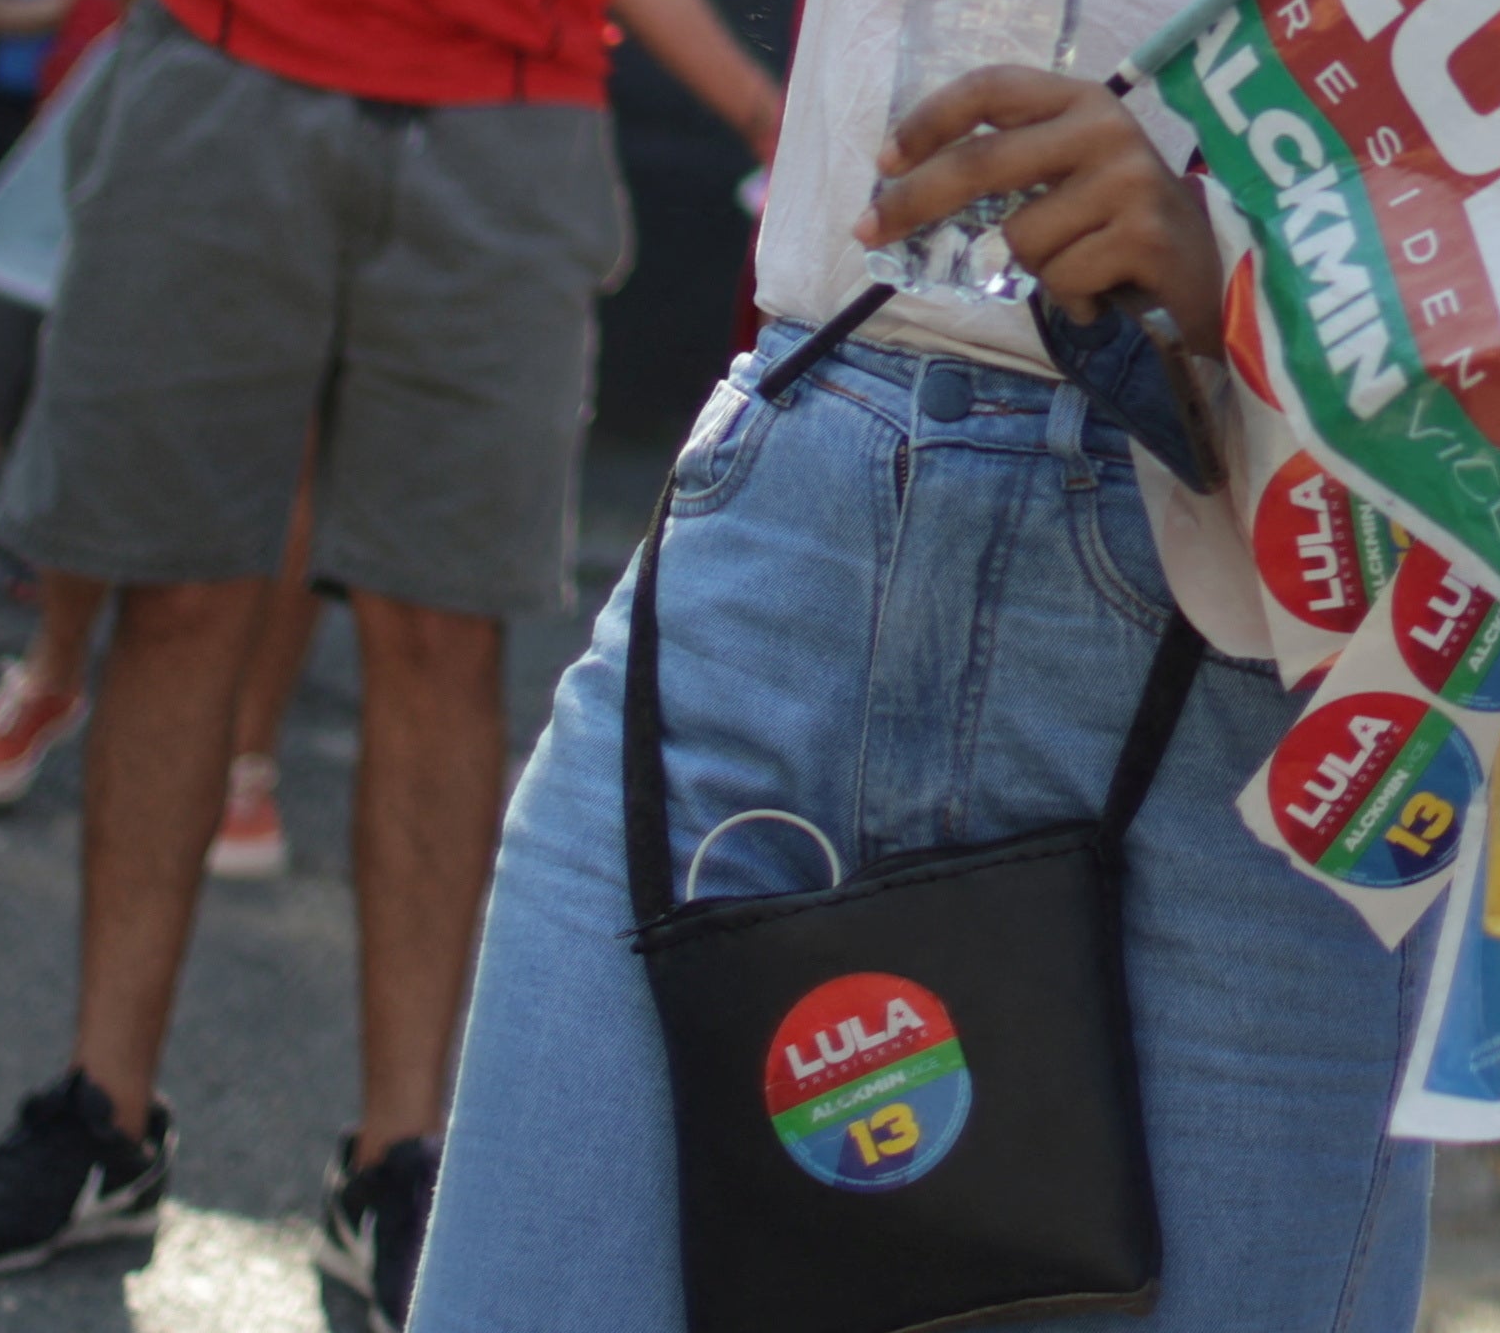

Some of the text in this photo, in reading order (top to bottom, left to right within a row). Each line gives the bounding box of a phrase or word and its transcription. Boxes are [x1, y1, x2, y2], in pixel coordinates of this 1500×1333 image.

[1288, 472, 1346, 612] LULA
[1284, 714, 1394, 830] LULA
[1343, 769, 1411, 854] ALCKMIN
[1384, 790, 1455, 859] 13
[784, 997, 927, 1081] LULA
[797, 1027, 930, 1091] PRESIDENTE
[811, 1069, 907, 1123] ALCKMIN
[847, 1102, 920, 1167] 13
